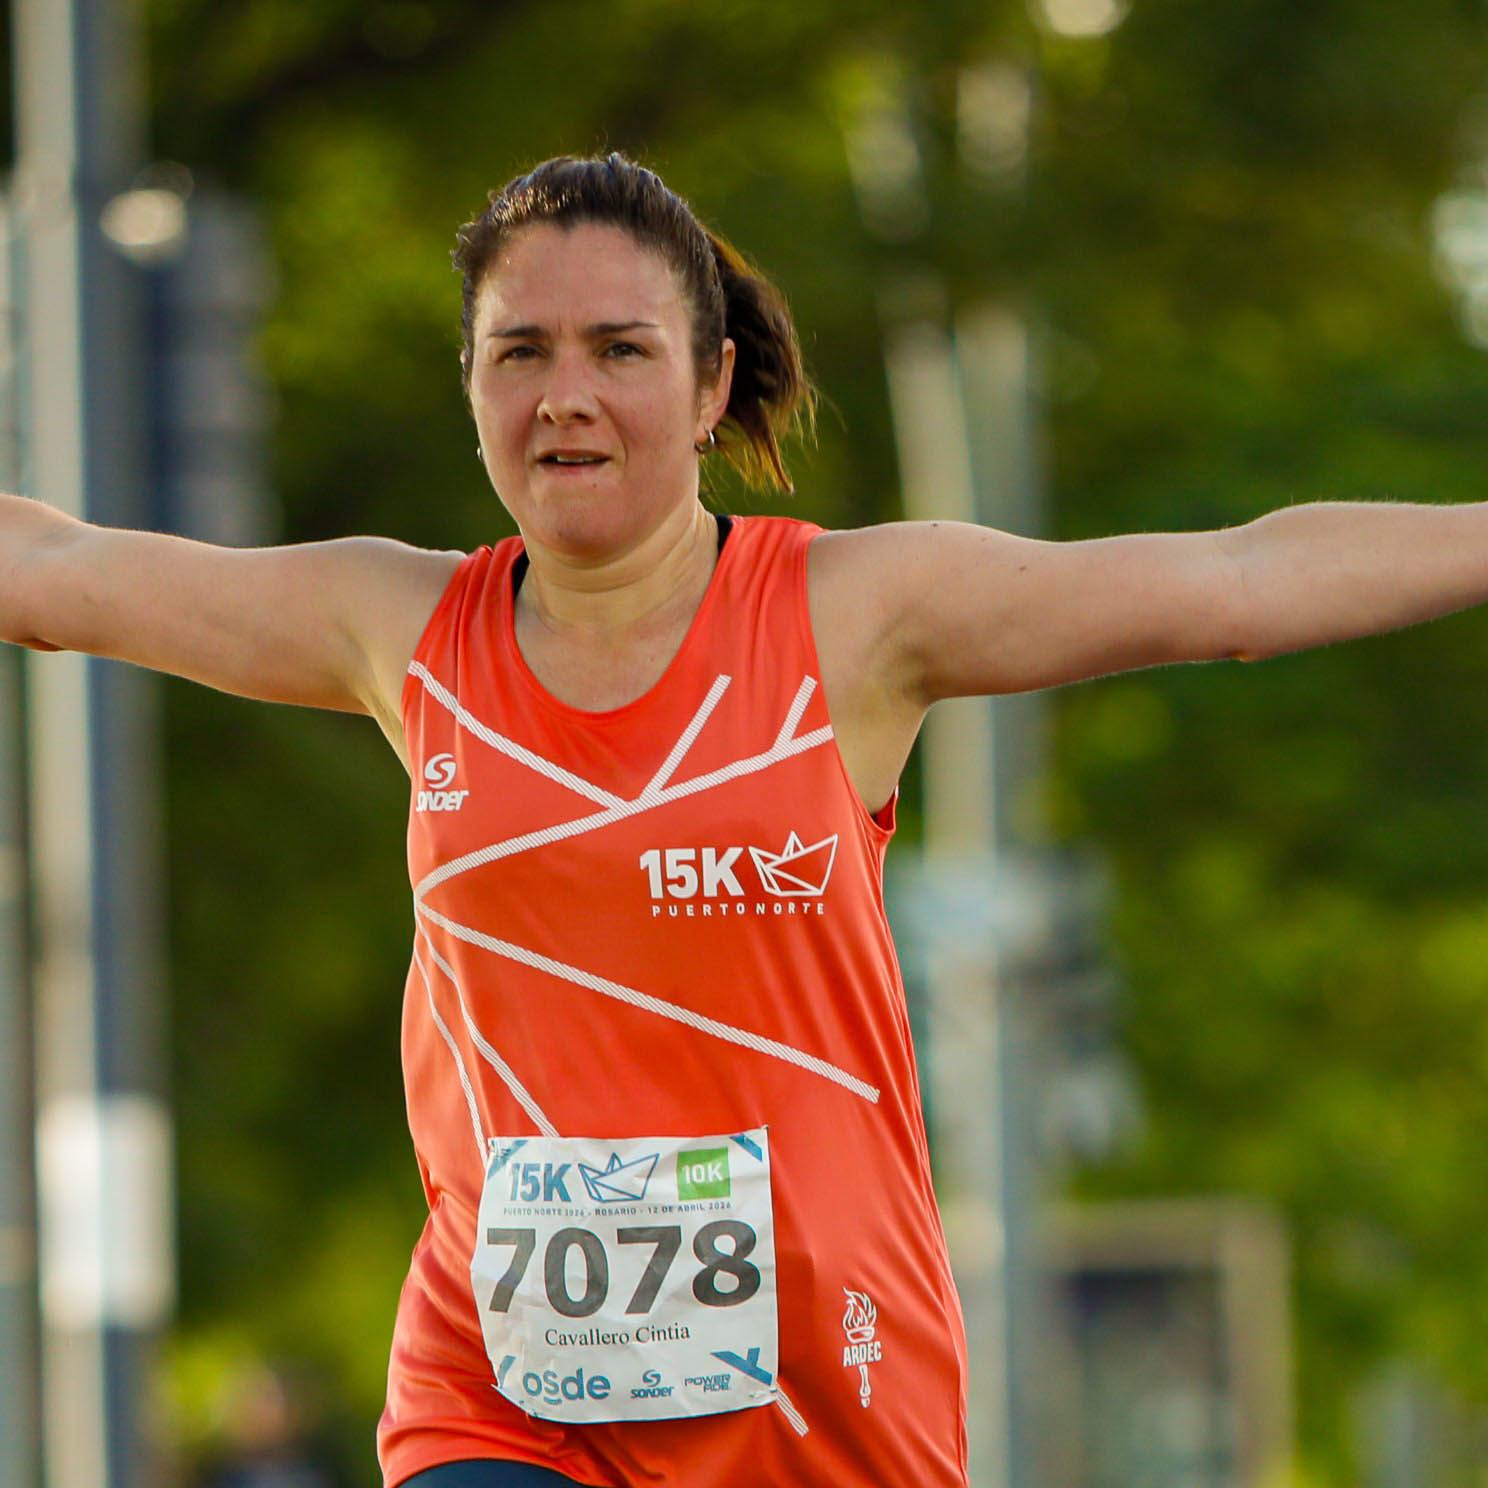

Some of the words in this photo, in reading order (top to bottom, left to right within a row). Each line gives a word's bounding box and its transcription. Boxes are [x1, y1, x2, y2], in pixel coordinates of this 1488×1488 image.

[640, 847, 745, 899] 15K
[510, 1163, 572, 1202] 15K
[681, 1161, 725, 1184] 10K
[503, 1207, 532, 1217] PUERTO
[534, 1207, 562, 1217] NORTE
[594, 1206, 637, 1217] ROSARIO
[647, 1206, 658, 1215] 12
[487, 1219, 761, 1318] 7078
[544, 1328, 630, 1346] Cavallero
[635, 1322, 690, 1343] Cintia
[842, 1341, 882, 1367] ARDEC
[522, 1367, 611, 1404] osde
